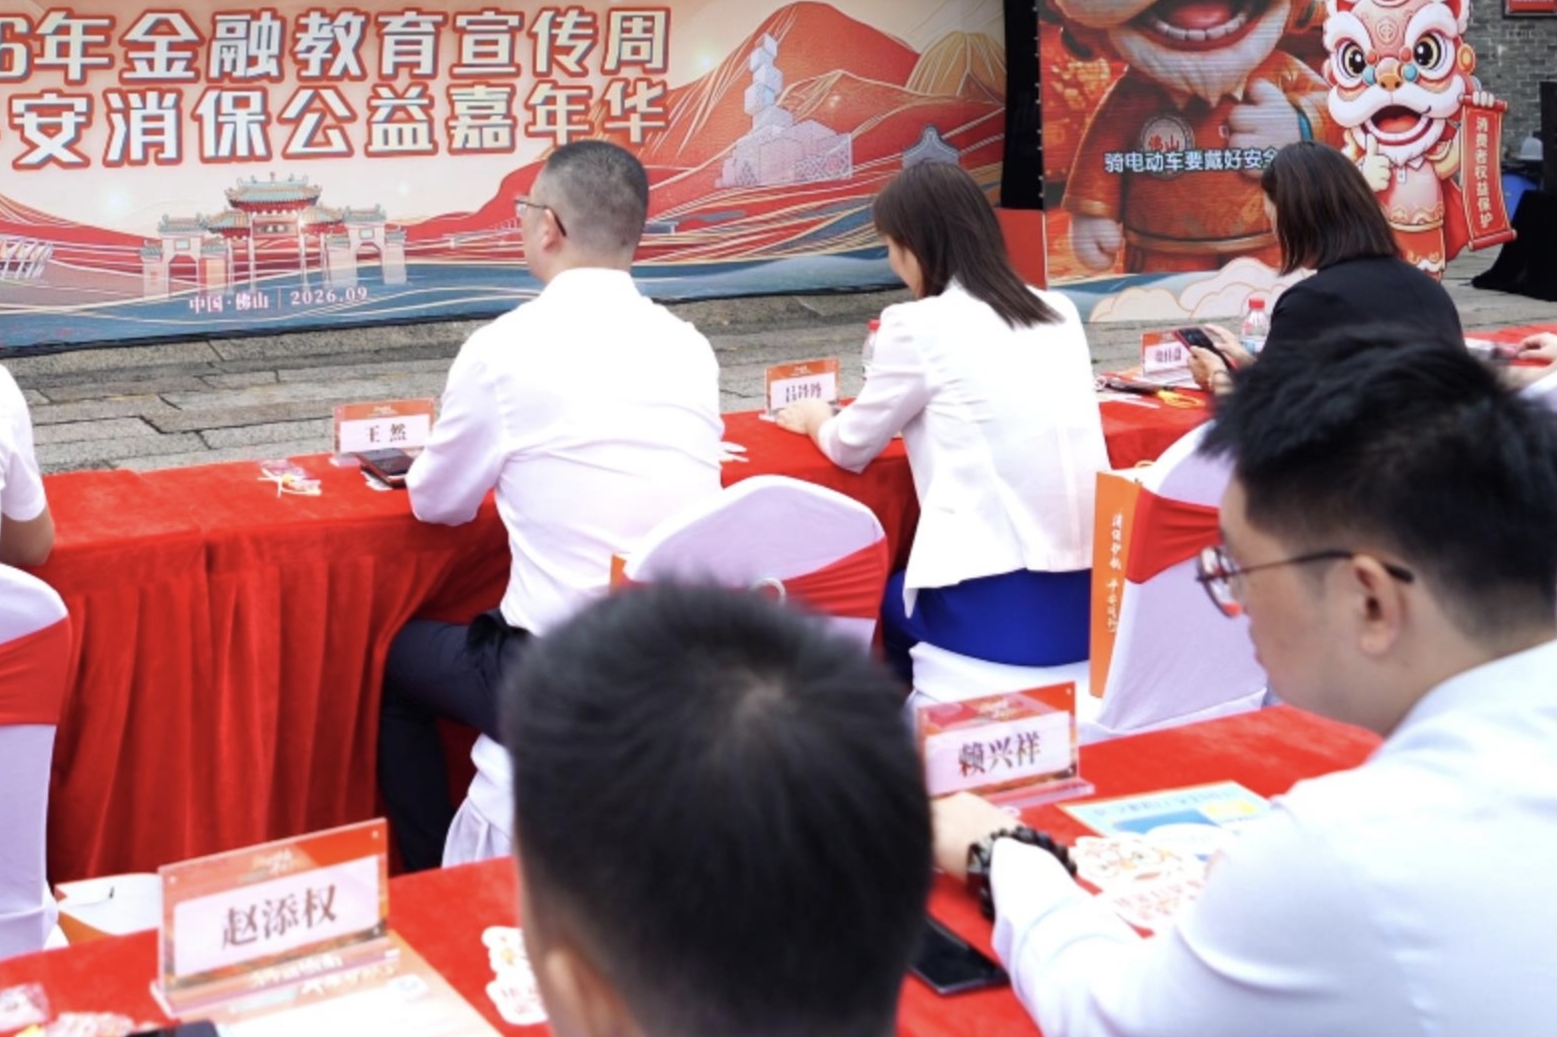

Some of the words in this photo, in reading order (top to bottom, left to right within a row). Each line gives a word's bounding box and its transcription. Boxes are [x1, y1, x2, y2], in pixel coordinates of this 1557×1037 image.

[1475, 116, 1493, 229] 消费者权益保护
[290, 286, 368, 306] 2026.09
[958, 730, 1041, 777] 赖兴祥
[222, 883, 337, 950] 赵添权
